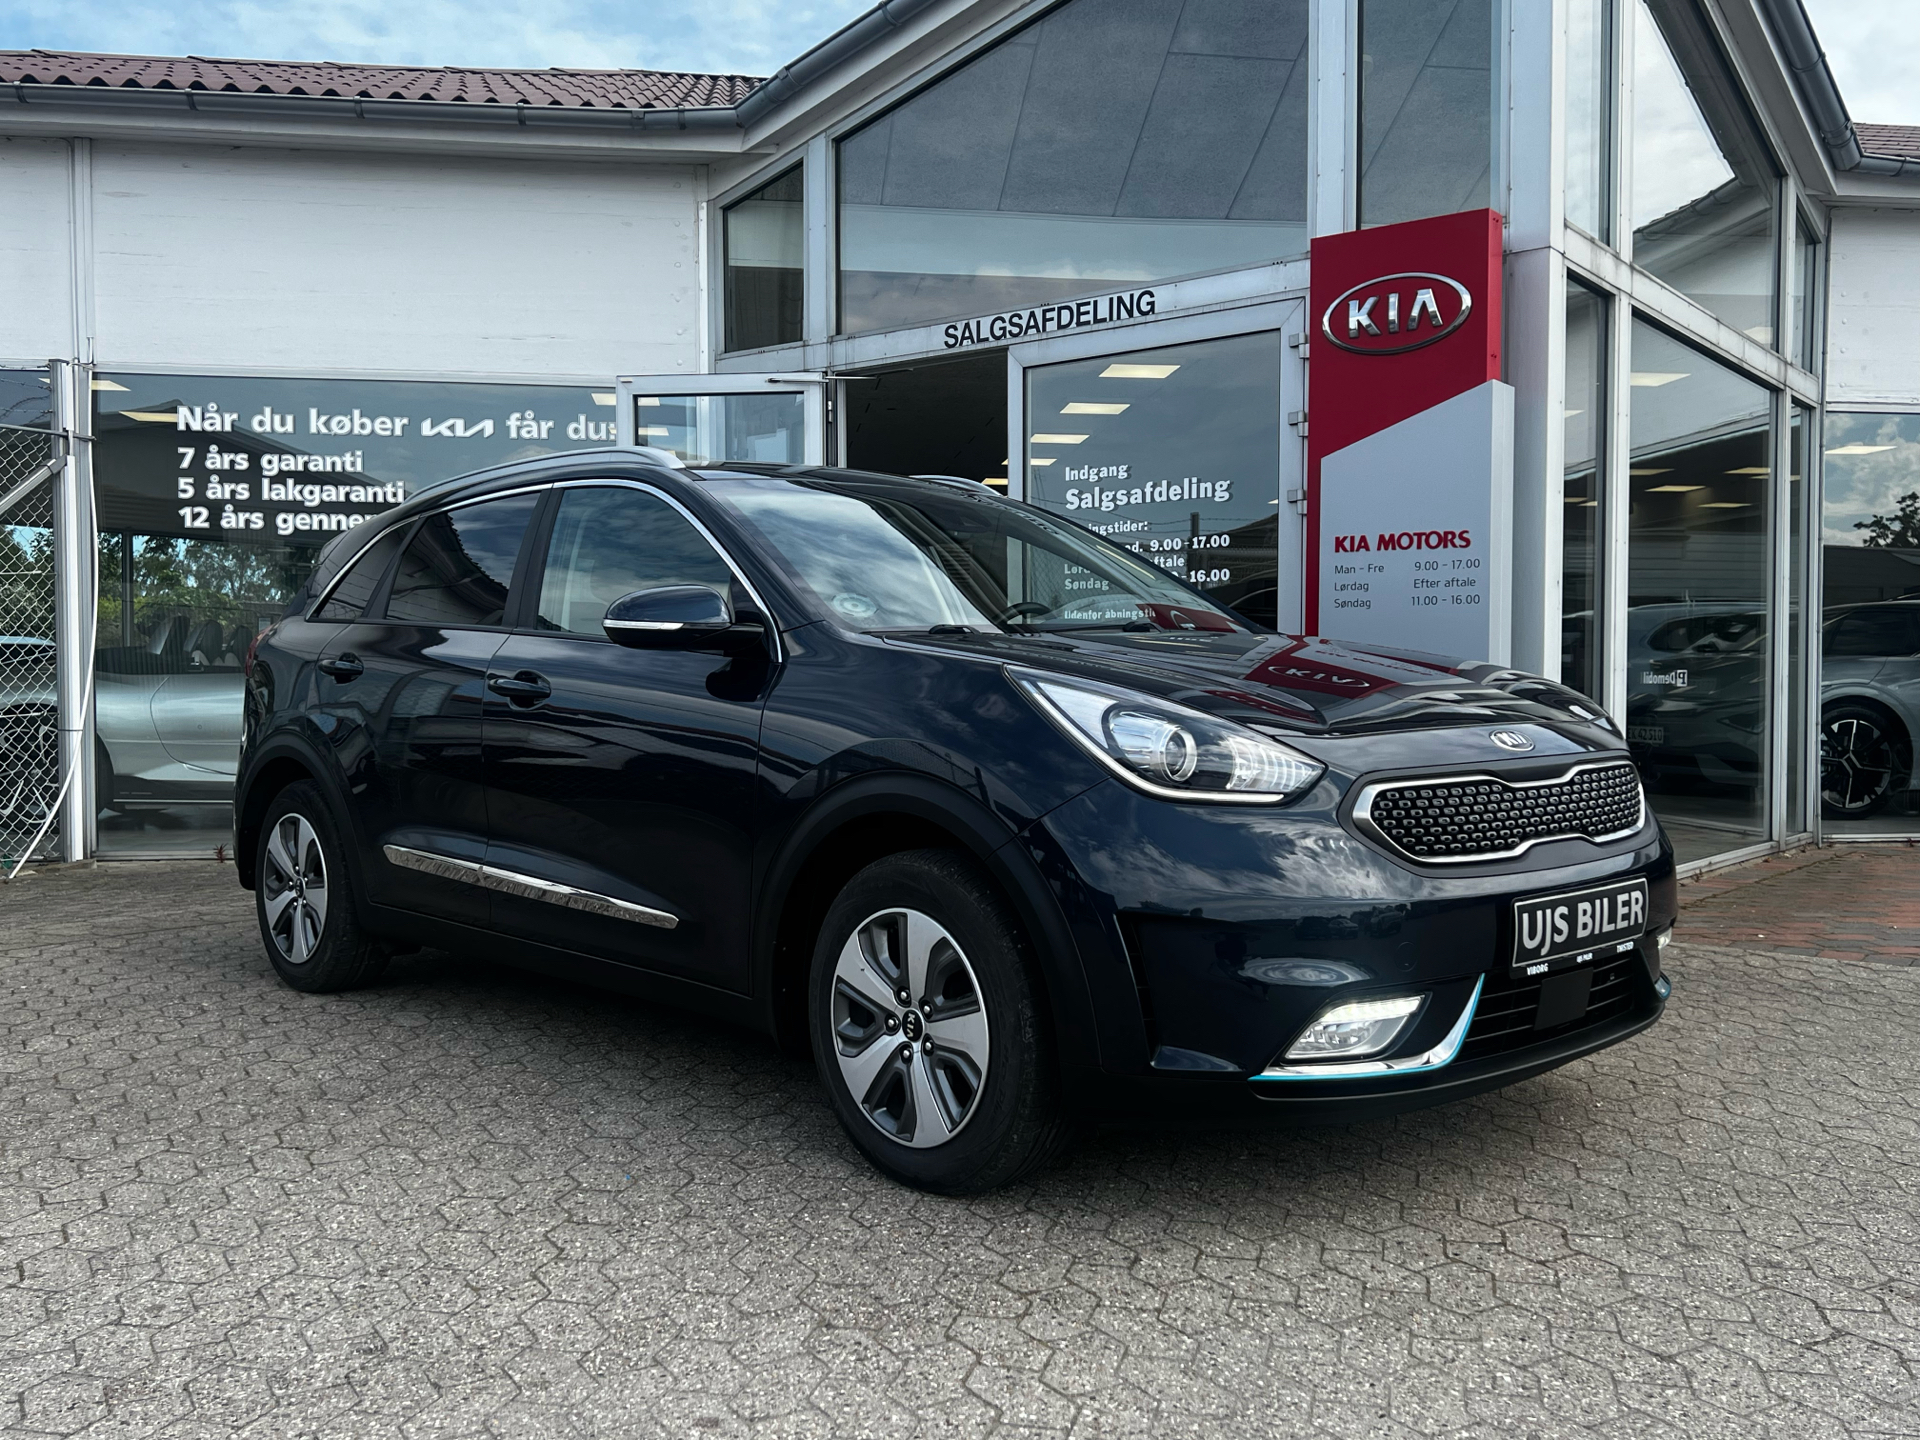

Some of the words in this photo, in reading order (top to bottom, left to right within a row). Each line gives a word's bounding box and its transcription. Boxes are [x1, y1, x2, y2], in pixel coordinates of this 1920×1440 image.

[944, 290, 1156, 349] SALGSAFDELING
[1348, 288, 1444, 339] KIA
[177, 402, 239, 432] Når
[252, 406, 295, 434] du
[309, 407, 410, 436] køber
[506, 410, 555, 440] får
[177, 447, 196, 469] 7
[205, 444, 250, 471] års
[260, 450, 364, 476] garanti
[1065, 464, 1129, 483] Indgang
[177, 477, 196, 499] 5
[206, 474, 250, 500] års
[261, 477, 405, 507] lakgaranti
[1065, 477, 1231, 511] Salgsafdeling
[178, 506, 210, 529] 12
[220, 503, 265, 530] års
[275, 512, 376, 535] genne
[1088, 521, 1149, 537] ingstider:
[1150, 538, 1182, 551] 9.00
[1192, 534, 1231, 549] 17.00
[1334, 535, 1371, 553] KIA
[1376, 530, 1472, 551] MOTORS
[1150, 555, 1185, 567] ftale
[1334, 565, 1356, 574] Man
[1368, 563, 1385, 573] Fre
[1414, 560, 1439, 571] 9.00
[1451, 559, 1480, 570] 17.00
[1065, 579, 1109, 590] Søndag
[1190, 569, 1231, 582] 16.00
[1414, 578, 1441, 588] Efter
[1444, 577, 1477, 587] aftale
[1334, 582, 1369, 592] Lørdag
[1334, 598, 1371, 609] Søndag
[1411, 596, 1438, 606] 11.00
[1451, 594, 1480, 605] 16.00
[1522, 905, 1569, 956] UJS
[1576, 890, 1644, 938] BILER
[906, 1013, 915, 1037] KIA
